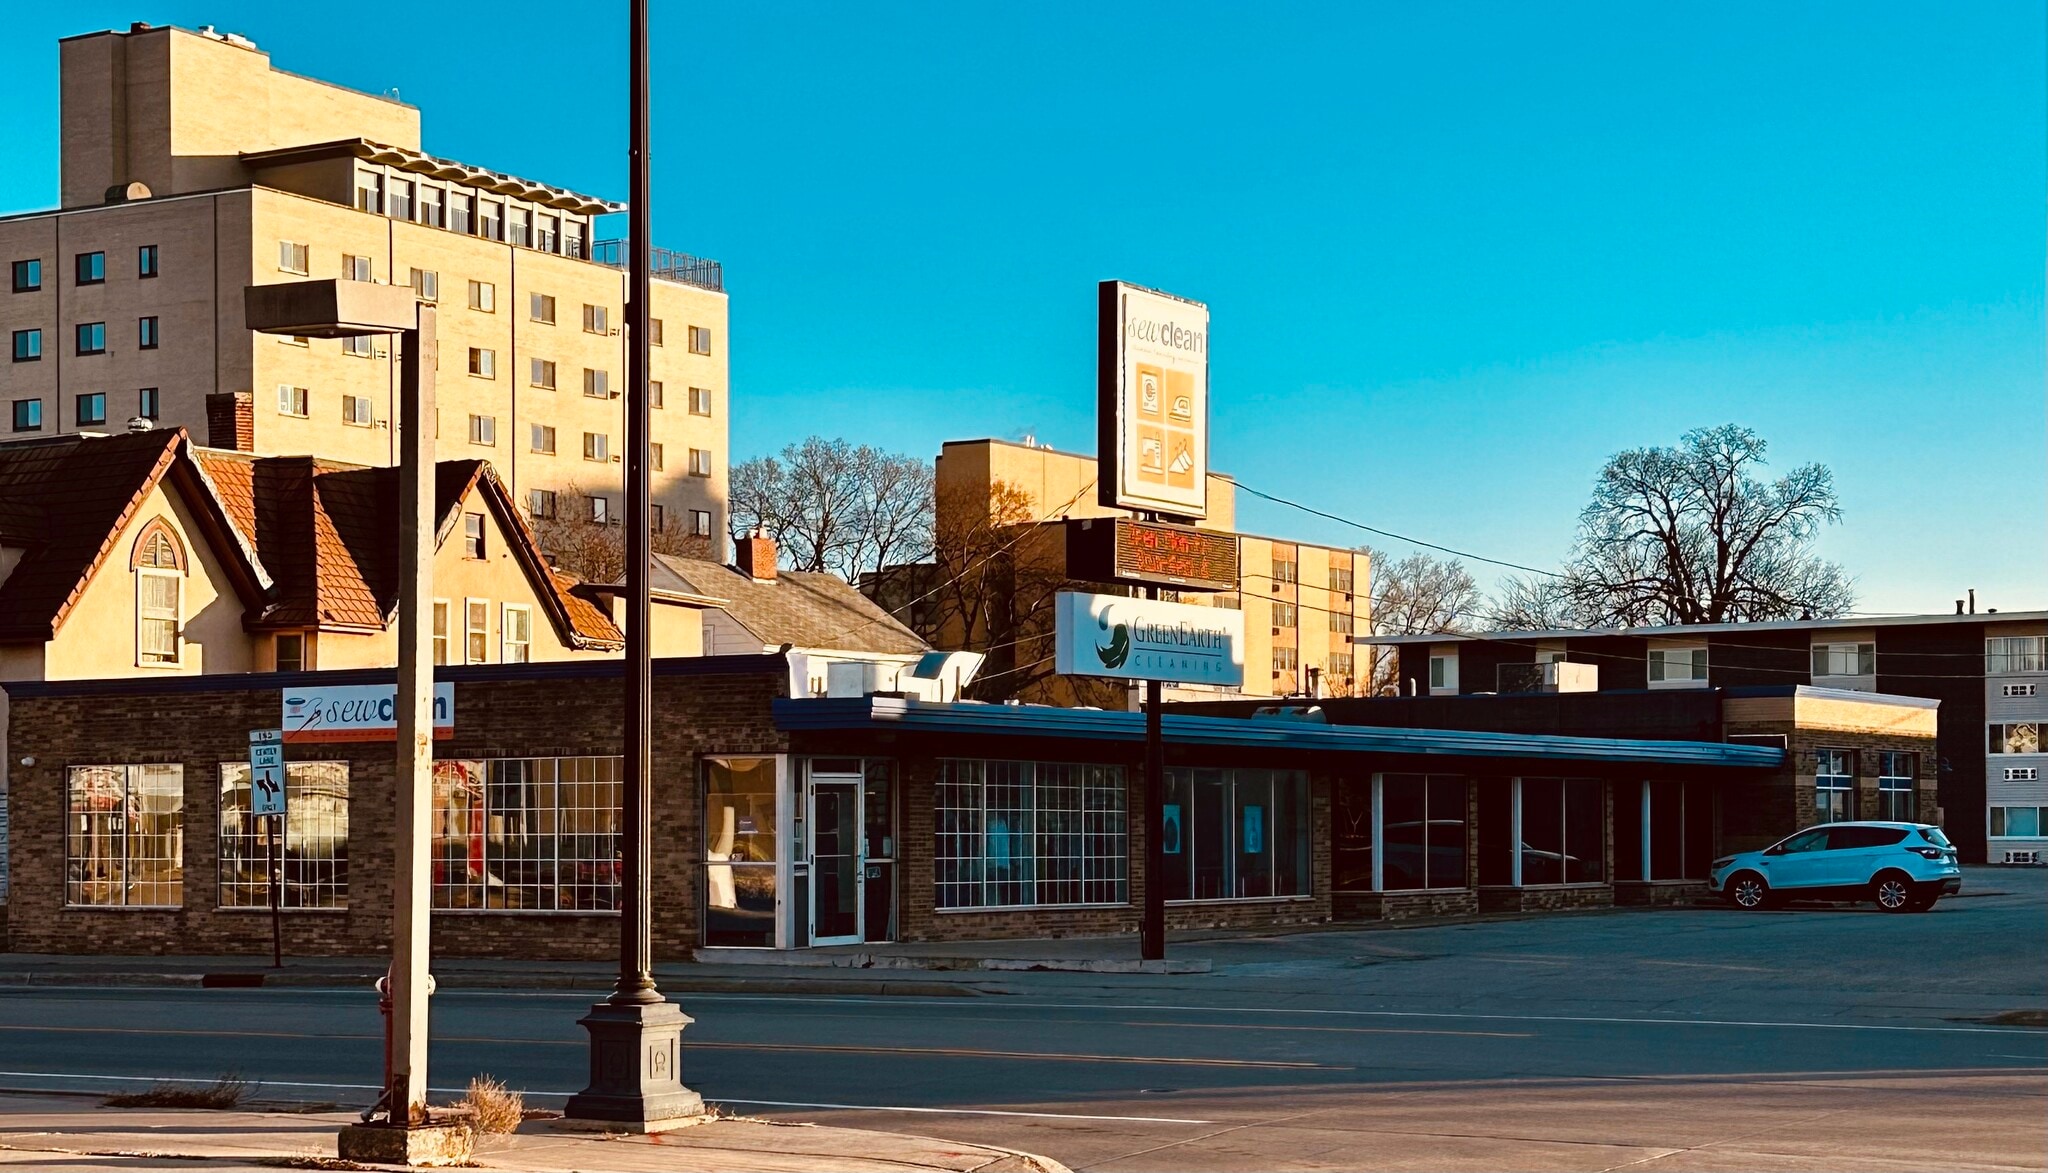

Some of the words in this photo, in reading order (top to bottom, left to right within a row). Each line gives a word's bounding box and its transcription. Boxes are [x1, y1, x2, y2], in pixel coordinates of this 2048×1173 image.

[1128, 317, 1203, 354] sewclean
[1134, 654, 1223, 672] CLEANING
[326, 693, 447, 723] sewcln
